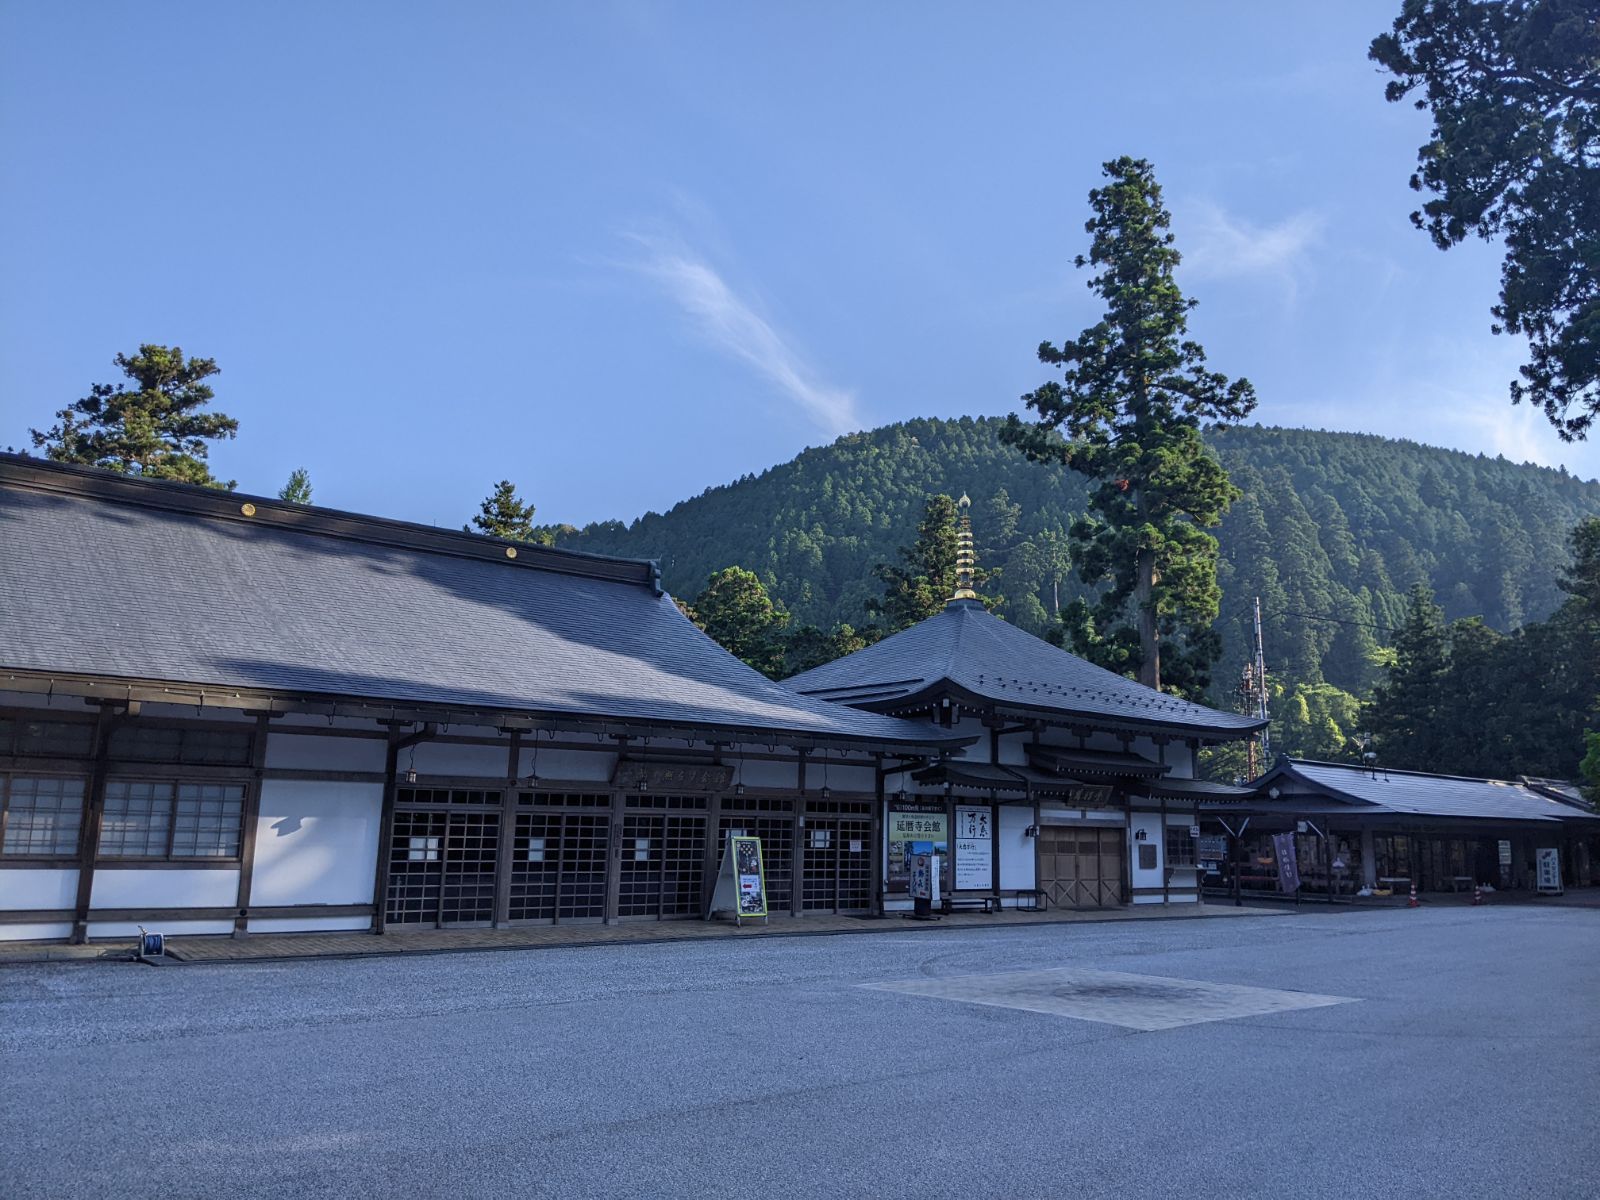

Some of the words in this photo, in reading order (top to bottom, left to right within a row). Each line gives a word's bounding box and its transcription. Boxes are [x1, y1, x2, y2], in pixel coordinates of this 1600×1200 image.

[896, 820, 941, 832] 延暦寺会館
